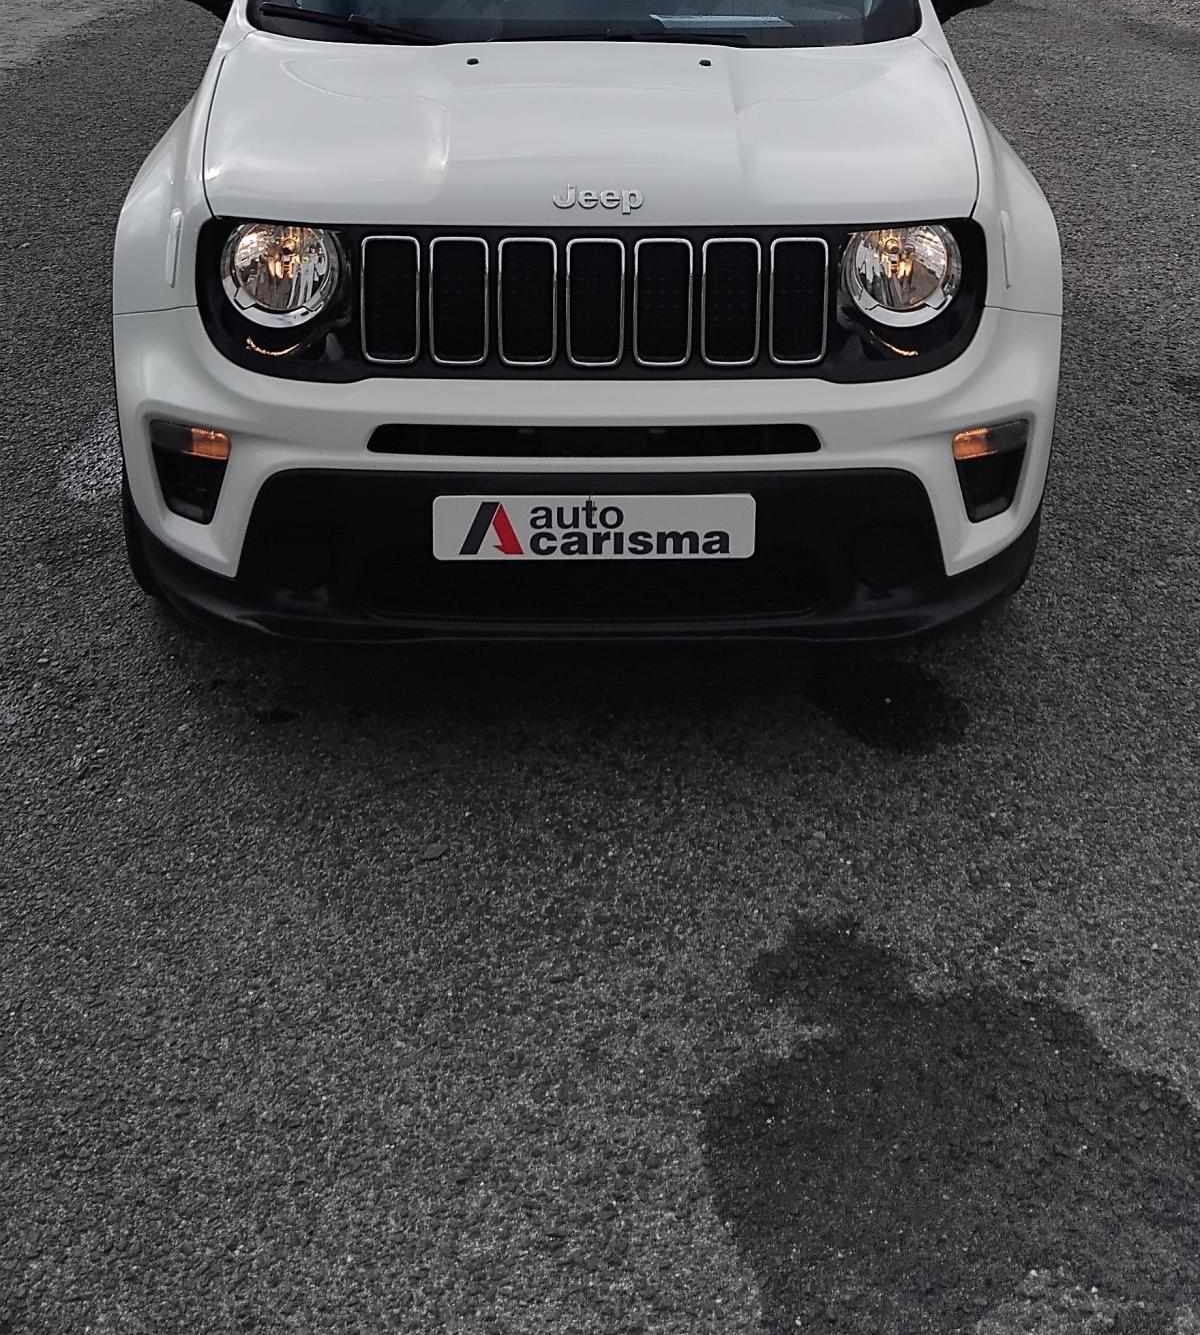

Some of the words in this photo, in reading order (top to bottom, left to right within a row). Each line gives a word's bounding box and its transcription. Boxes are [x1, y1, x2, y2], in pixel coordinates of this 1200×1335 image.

[552, 183, 644, 215] Jeep
[529, 500, 624, 529] auto
[529, 530, 731, 556] carisma
